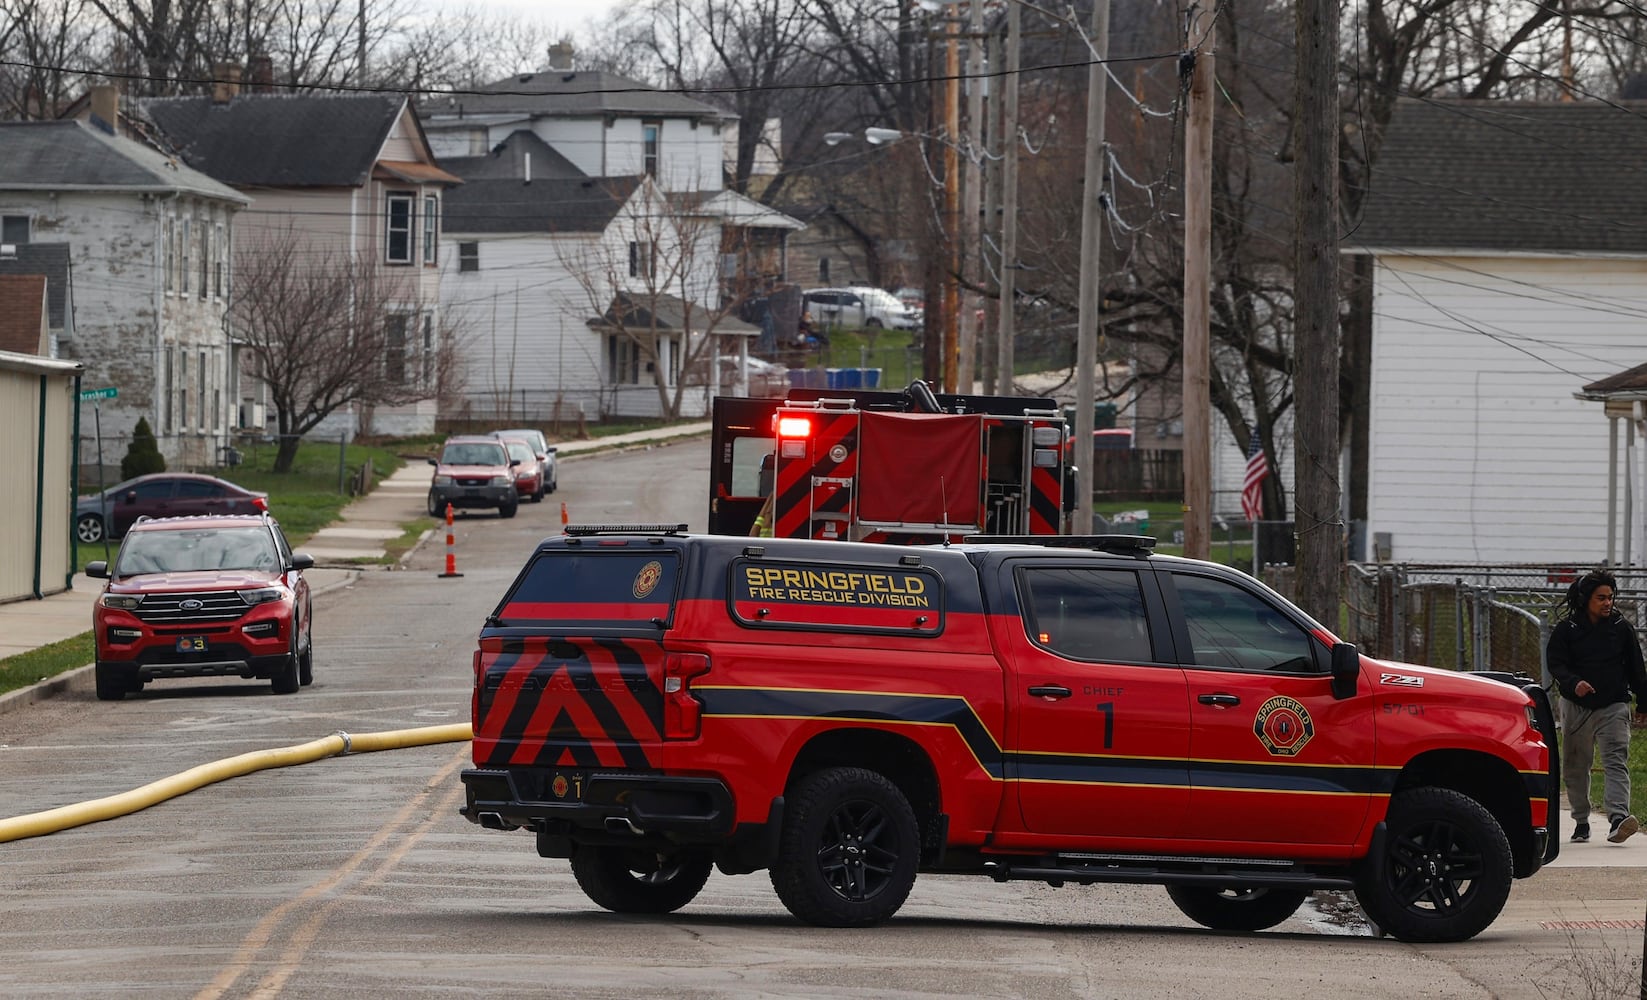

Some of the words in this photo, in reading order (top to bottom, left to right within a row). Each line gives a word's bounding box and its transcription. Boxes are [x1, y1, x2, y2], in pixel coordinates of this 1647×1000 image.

[80, 391, 107, 400] hrasher
[746, 567, 925, 594] SPRINGFIELD
[749, 587, 786, 600] FIRE
[789, 589, 857, 604] RESCUE
[858, 592, 929, 607] DIVISION
[194, 640, 204, 650] 3
[1083, 686, 1124, 697] CHIEF
[1258, 698, 1310, 725] SPRINGFIELD
[1097, 701, 1113, 749] 1
[1261, 734, 1272, 749] FIRE
[1291, 732, 1310, 754] RESCUE
[575, 781, 581, 799] 1
